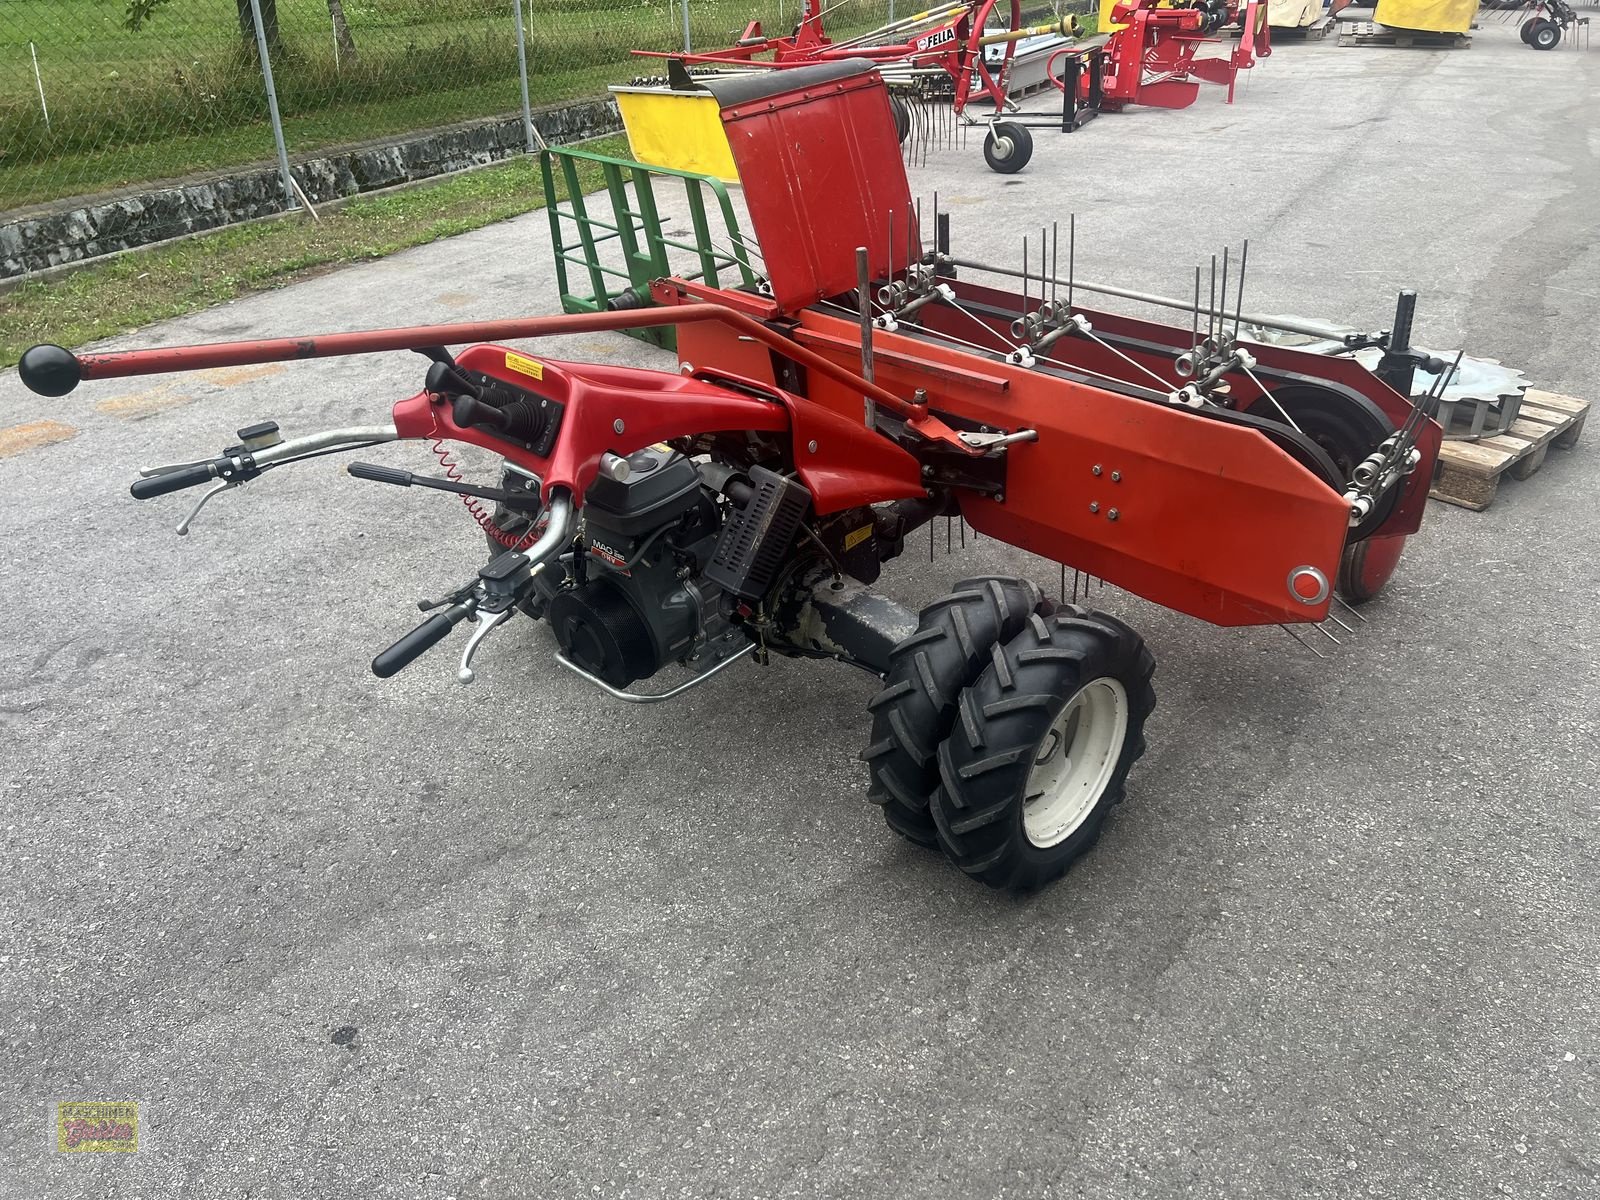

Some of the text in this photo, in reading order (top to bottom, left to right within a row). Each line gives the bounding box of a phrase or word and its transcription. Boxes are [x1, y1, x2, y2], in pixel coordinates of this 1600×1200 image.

[927, 28, 954, 48] FELLA
[545, 424, 552, 435] 2
[592, 539, 613, 555] MAG
